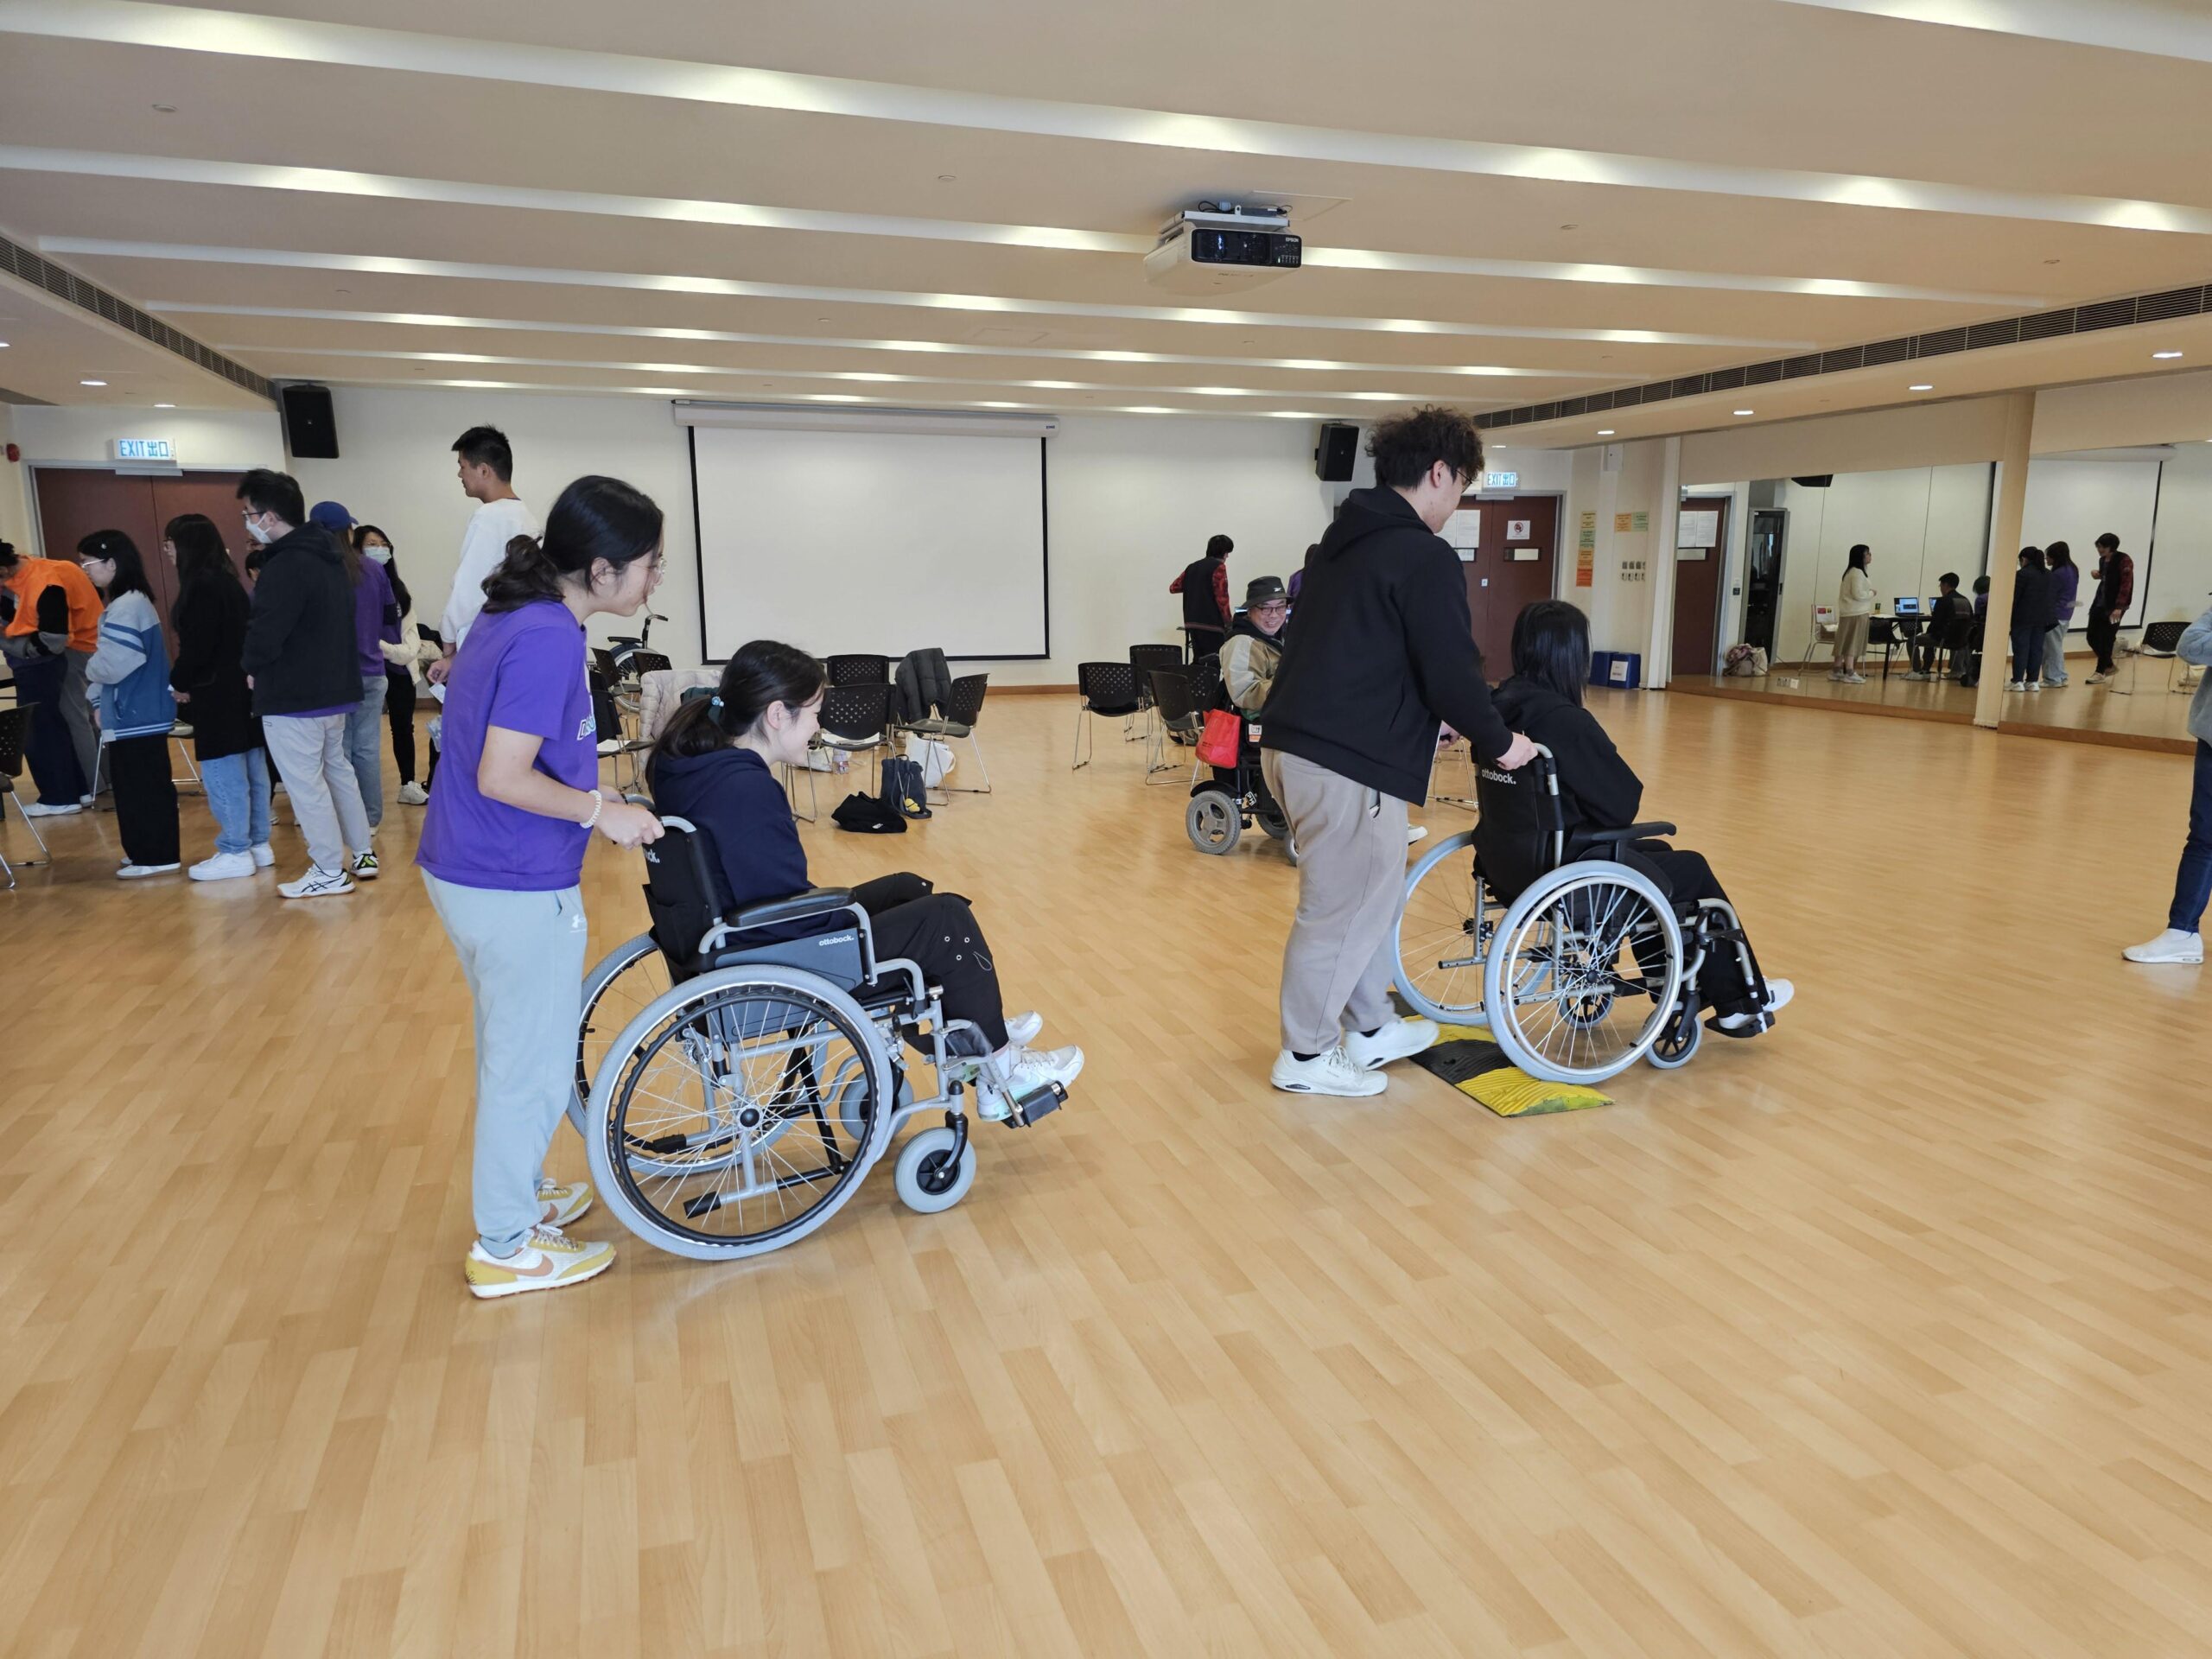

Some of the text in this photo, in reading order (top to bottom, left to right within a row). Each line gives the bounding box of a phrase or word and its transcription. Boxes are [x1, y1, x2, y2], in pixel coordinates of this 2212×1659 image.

[119, 440, 169, 457] EXIT 出口
[1487, 473, 1516, 486] EXIT 出口
